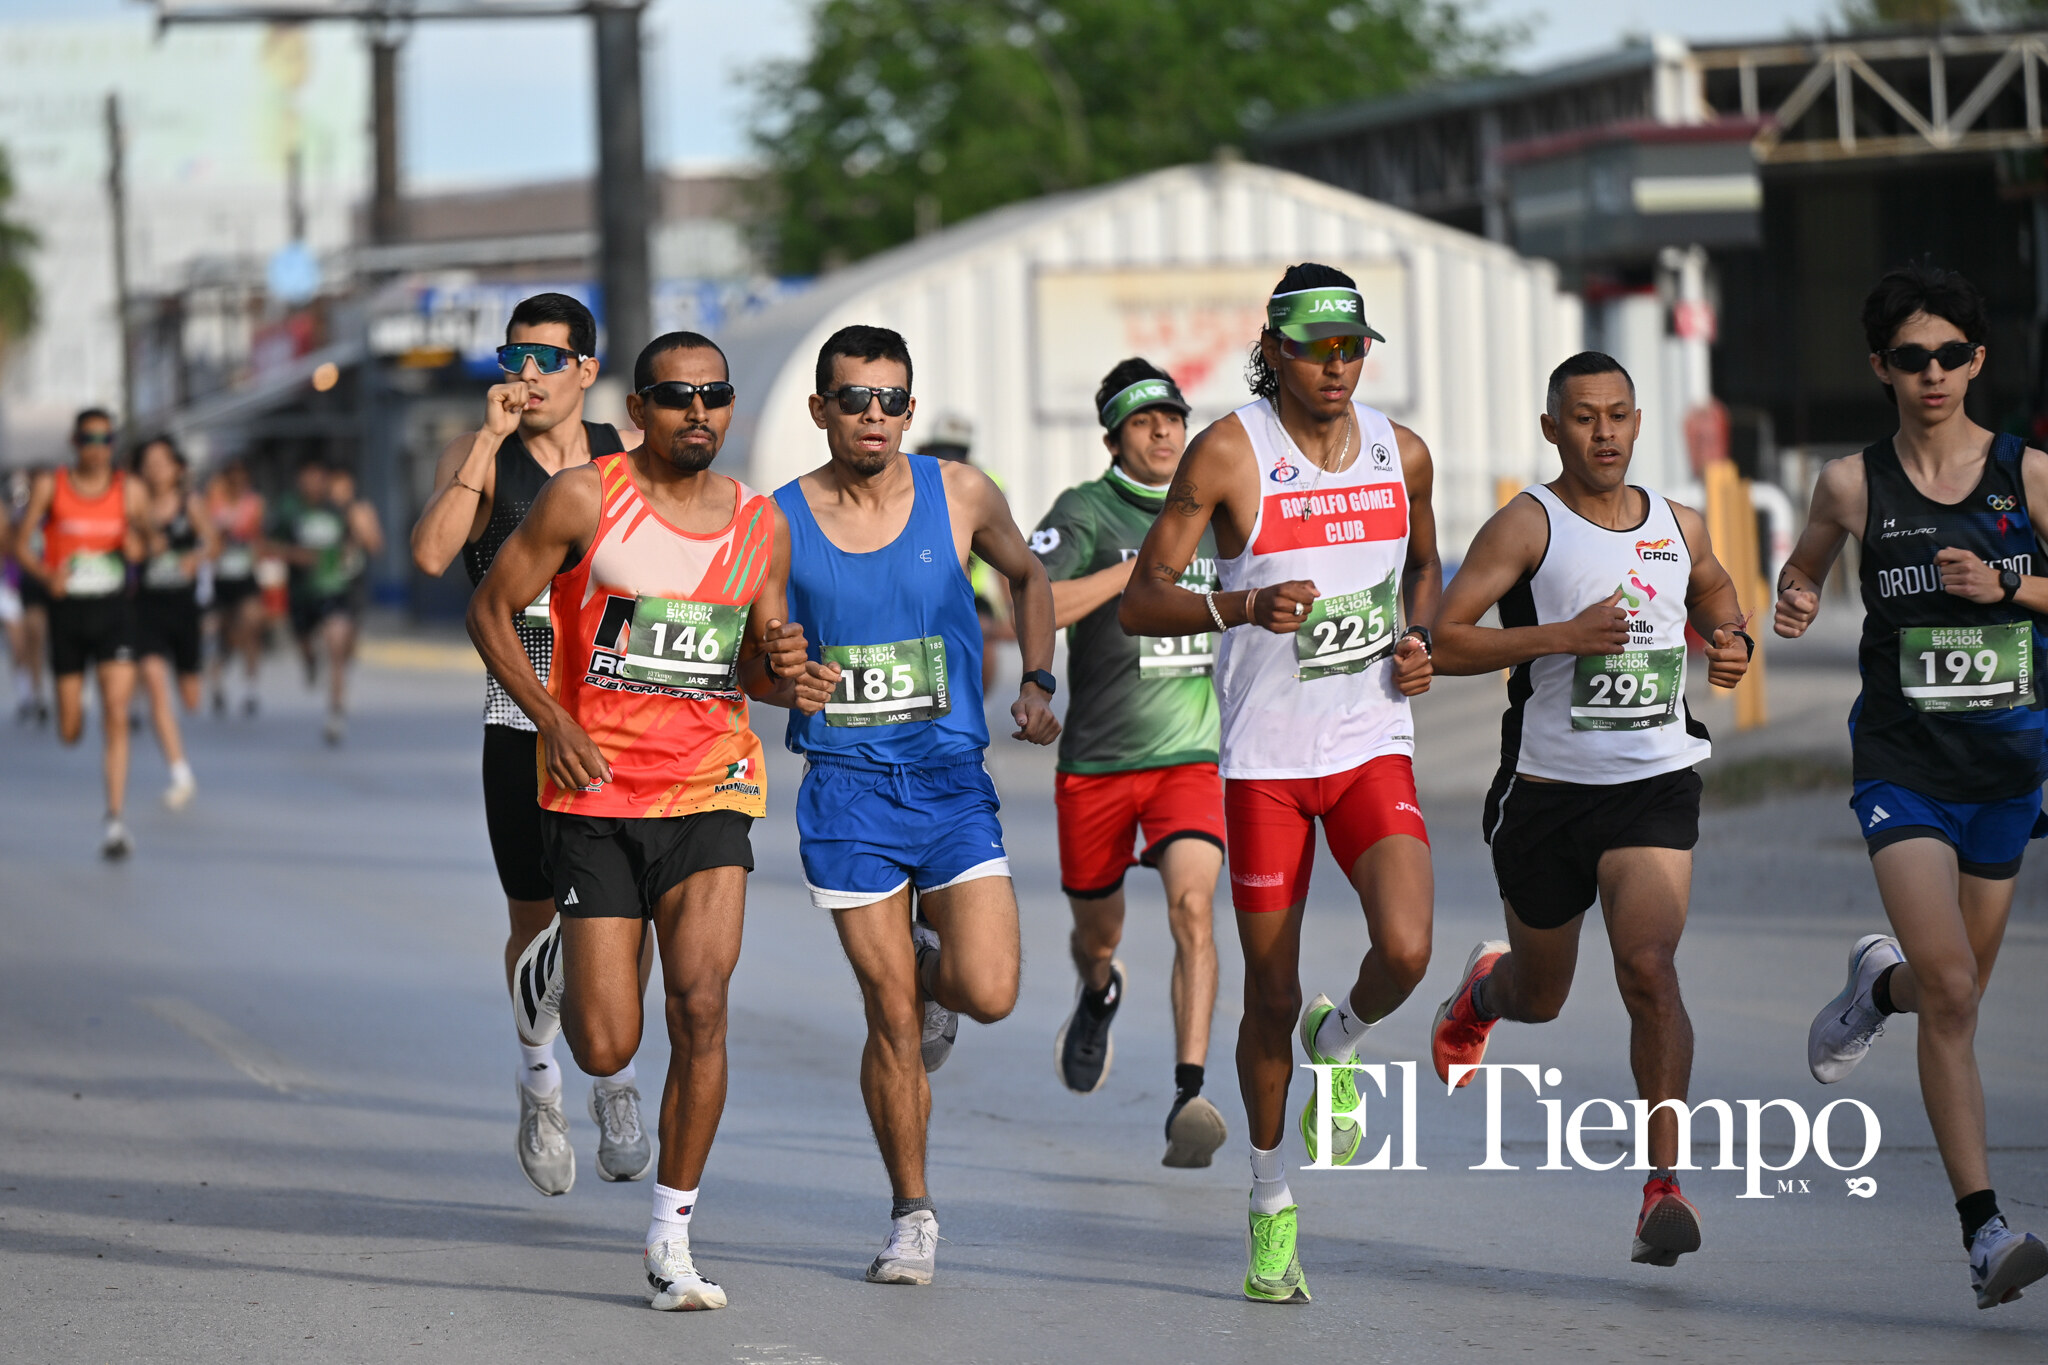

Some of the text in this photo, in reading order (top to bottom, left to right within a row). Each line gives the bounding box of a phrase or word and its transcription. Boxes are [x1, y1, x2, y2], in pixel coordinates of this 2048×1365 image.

[1280, 487, 1396, 519] RODOLFO GÓMEZ
[1325, 520, 1366, 543] CLUB
[1881, 528, 1937, 539] ARTURO
[667, 601, 713, 612] CARRERA
[1324, 590, 1372, 606] CARRERA
[650, 622, 720, 661] 146
[930, 642, 943, 650] 185
[1313, 605, 1385, 656] 225
[848, 645, 895, 655] CARRERA
[1605, 652, 1649, 660] CARRERA
[840, 664, 915, 701] 185
[933, 654, 947, 708] MEDALLA
[1919, 649, 1998, 684] 199
[2018, 640, 2029, 695] MEDALLA
[584, 674, 620, 691] CLUB
[618, 682, 660, 695] NORA
[1588, 672, 1659, 706] 295
[1668, 664, 1680, 715] MEDALLA
